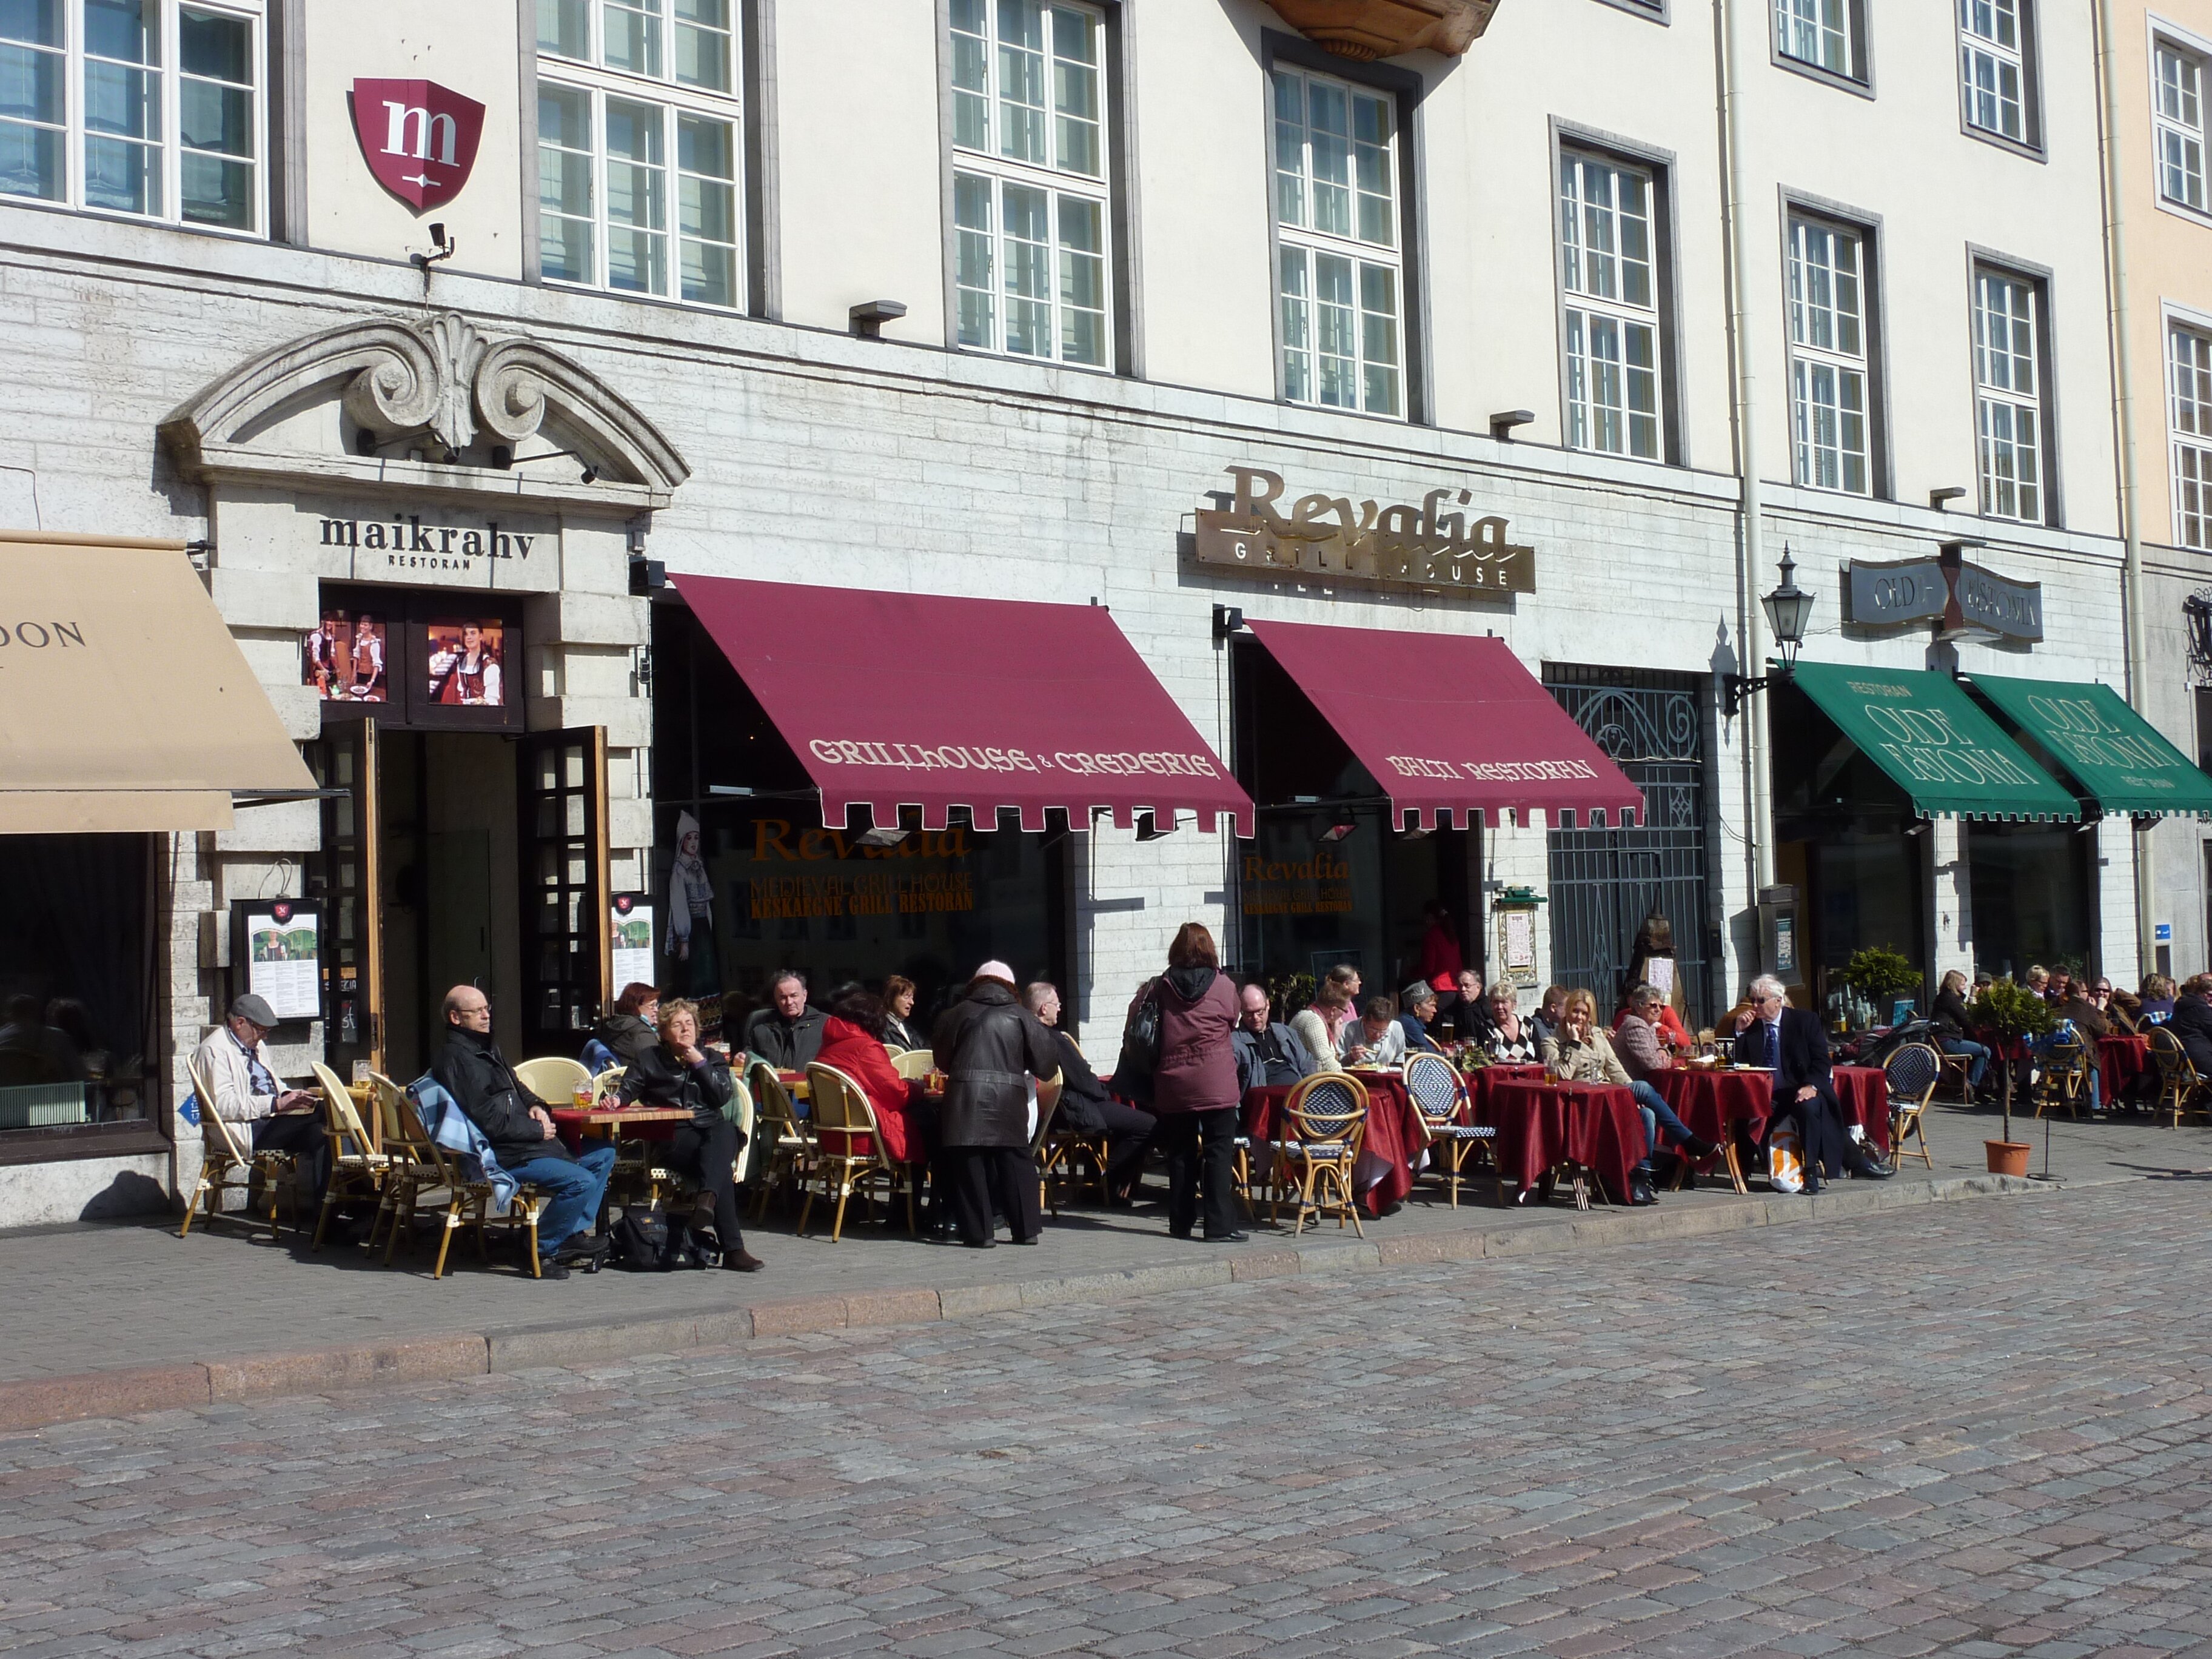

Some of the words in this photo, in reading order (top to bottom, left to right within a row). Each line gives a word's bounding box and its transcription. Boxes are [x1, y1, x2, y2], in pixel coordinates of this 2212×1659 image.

[1224, 464, 1516, 561] Revalia
[319, 513, 535, 560] maikrahv
[388, 554, 471, 571] RESTORAN
[1235, 542, 1354, 571] GRILL
[1401, 561, 1508, 586] HOUSE
[1847, 681, 1912, 697] RESTORAN
[1865, 704, 1974, 745] OLDE
[2028, 695, 2121, 734] OLDE
[1037, 754, 1055, 768] &
[1054, 752, 1221, 780] CREPERIE
[1879, 742, 2040, 785] ESTONIA
[2046, 729, 2180, 769] ESTONIA
[1385, 756, 1464, 781] BALTI
[1461, 759, 1598, 782] RESTORAN
[1244, 851, 1349, 881] Revalia
[750, 876, 849, 898] MEDIEVAL
[911, 872, 973, 893] HOUSE
[751, 896, 843, 920] KESKAEGNE
[850, 894, 893, 916] GRILL
[899, 892, 973, 914] RESTORAN
